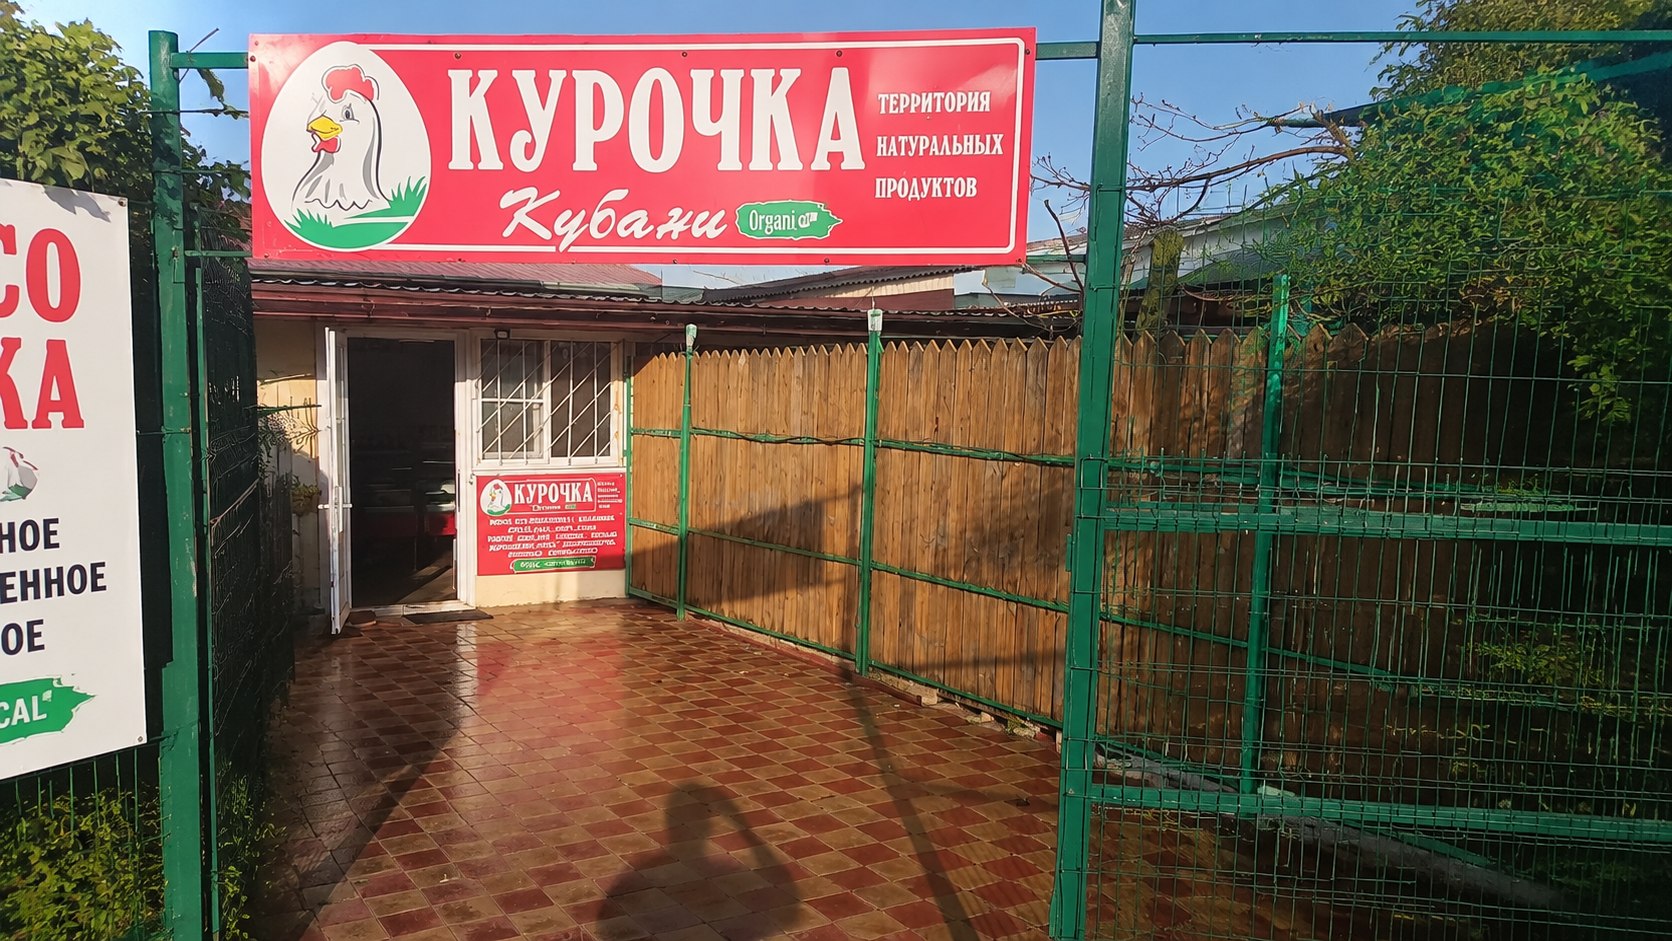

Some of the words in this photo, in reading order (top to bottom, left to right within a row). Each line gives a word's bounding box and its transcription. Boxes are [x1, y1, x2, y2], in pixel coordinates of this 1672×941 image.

[447, 67, 865, 173] КУРОЧКА
[877, 91, 991, 115] ТЕРРИТОРИЯ
[876, 133, 1004, 157] НАТУРАЛЬНЫХ
[874, 177, 978, 201] ПРОДУКТОВ
[499, 186, 728, 252] Кубани
[513, 481, 593, 504] КУРОЧКА
[0, 517, 60, 554] НОЕ
[0, 561, 107, 604] ЕННОЕ
[0, 619, 46, 656] ОЕ
